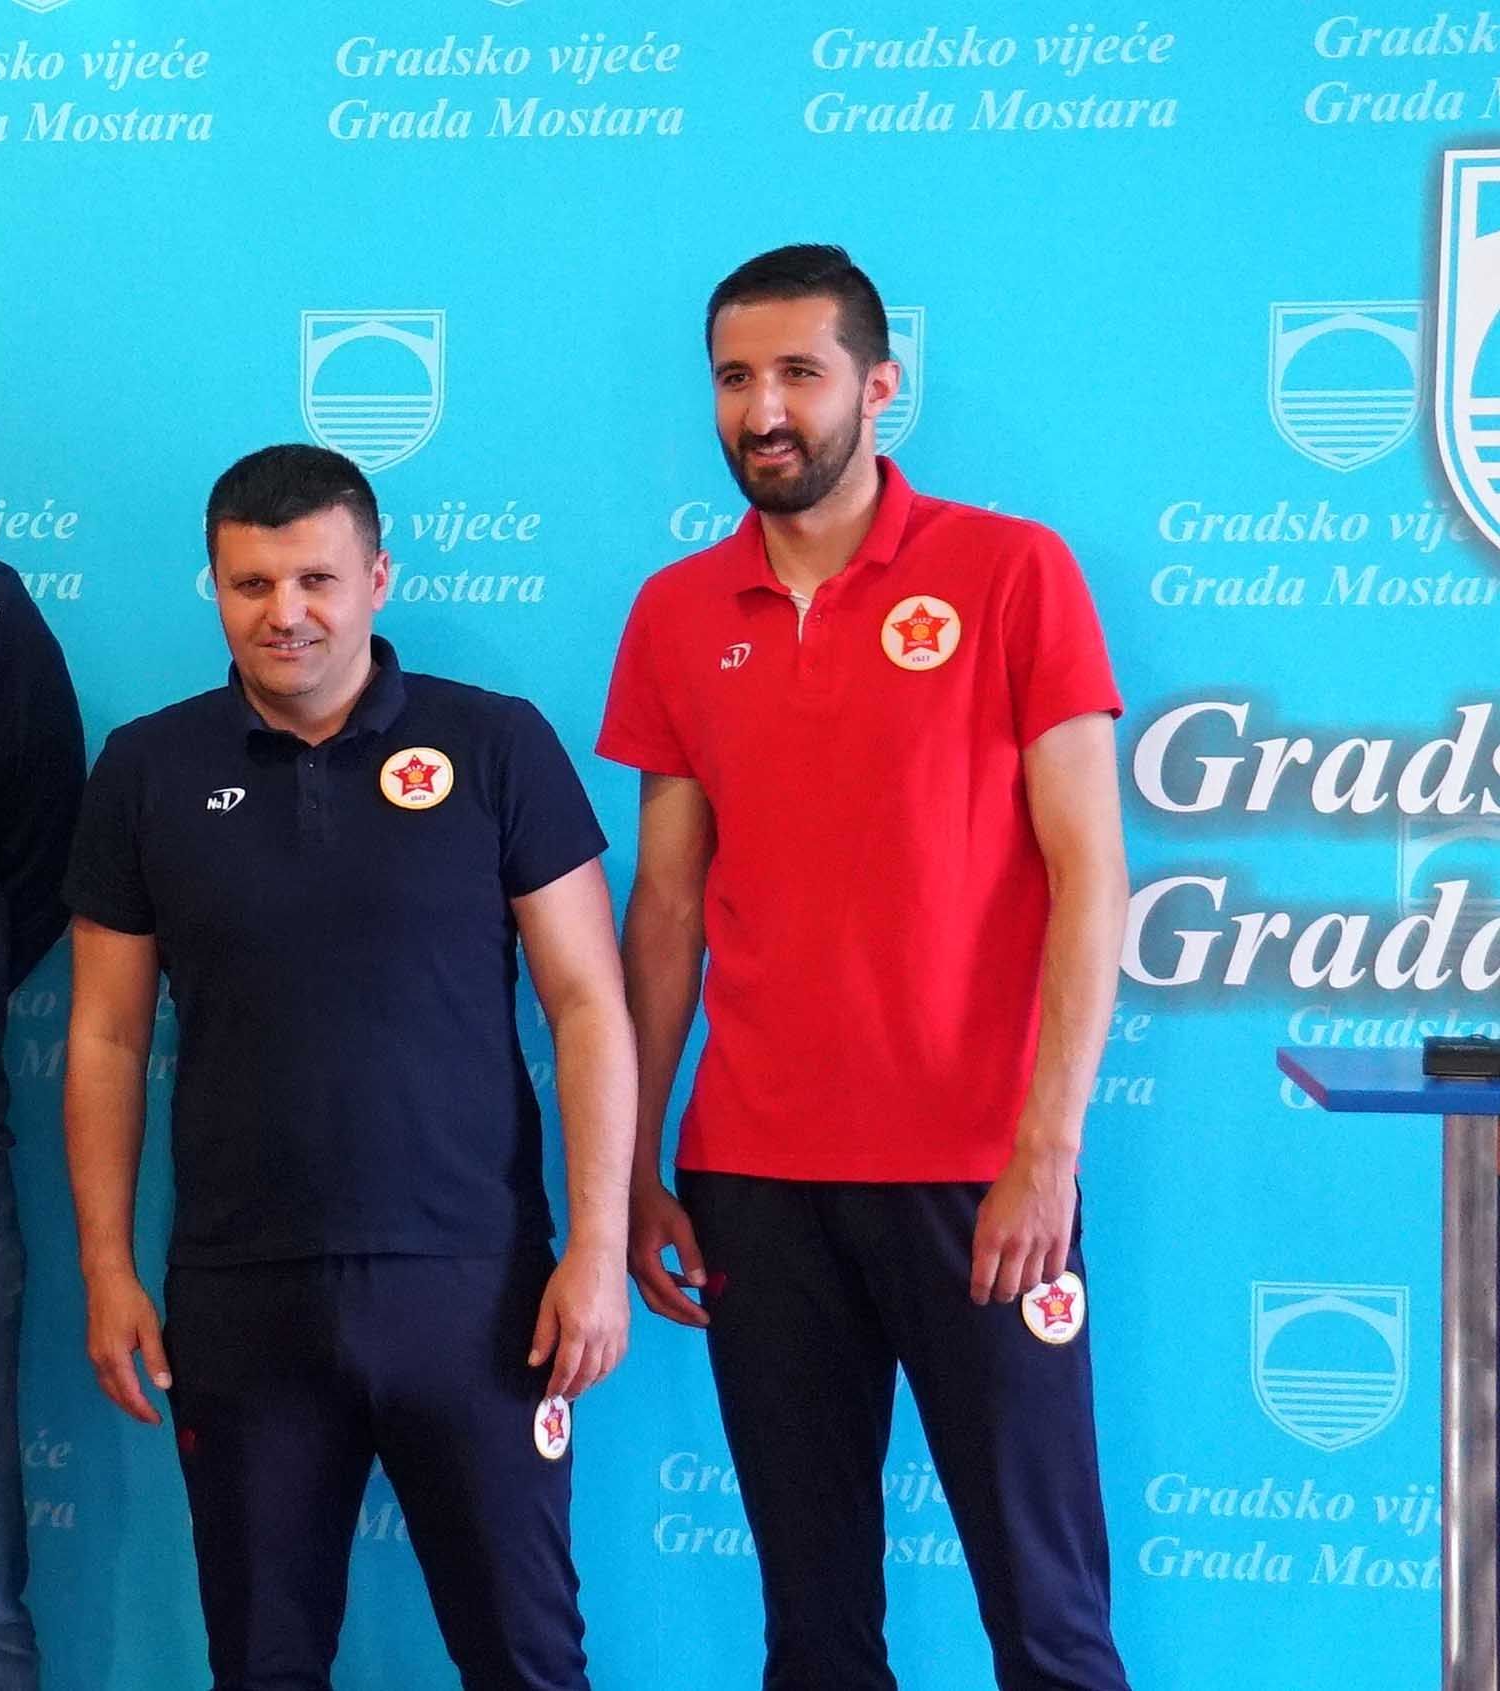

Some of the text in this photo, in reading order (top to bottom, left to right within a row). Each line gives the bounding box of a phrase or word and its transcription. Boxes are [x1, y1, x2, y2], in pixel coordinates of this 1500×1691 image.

[84, 39, 210, 89] vijeće
[335, 33, 681, 84] Gradsko vijeće
[812, 22, 1175, 77] Gradsko vijeće
[22, 101, 213, 141] Mostara
[328, 98, 684, 139] Grada Mostara
[804, 89, 1178, 133] Grada Mostara
[1304, 79, 1465, 124] Grada
[411, 500, 541, 552] vijeće
[1158, 500, 1369, 542] Gradsko
[1150, 563, 1306, 606] Grada
[1144, 1473, 1440, 1535] Gradsko vij
[1138, 1536, 1441, 1589] Grada Most
